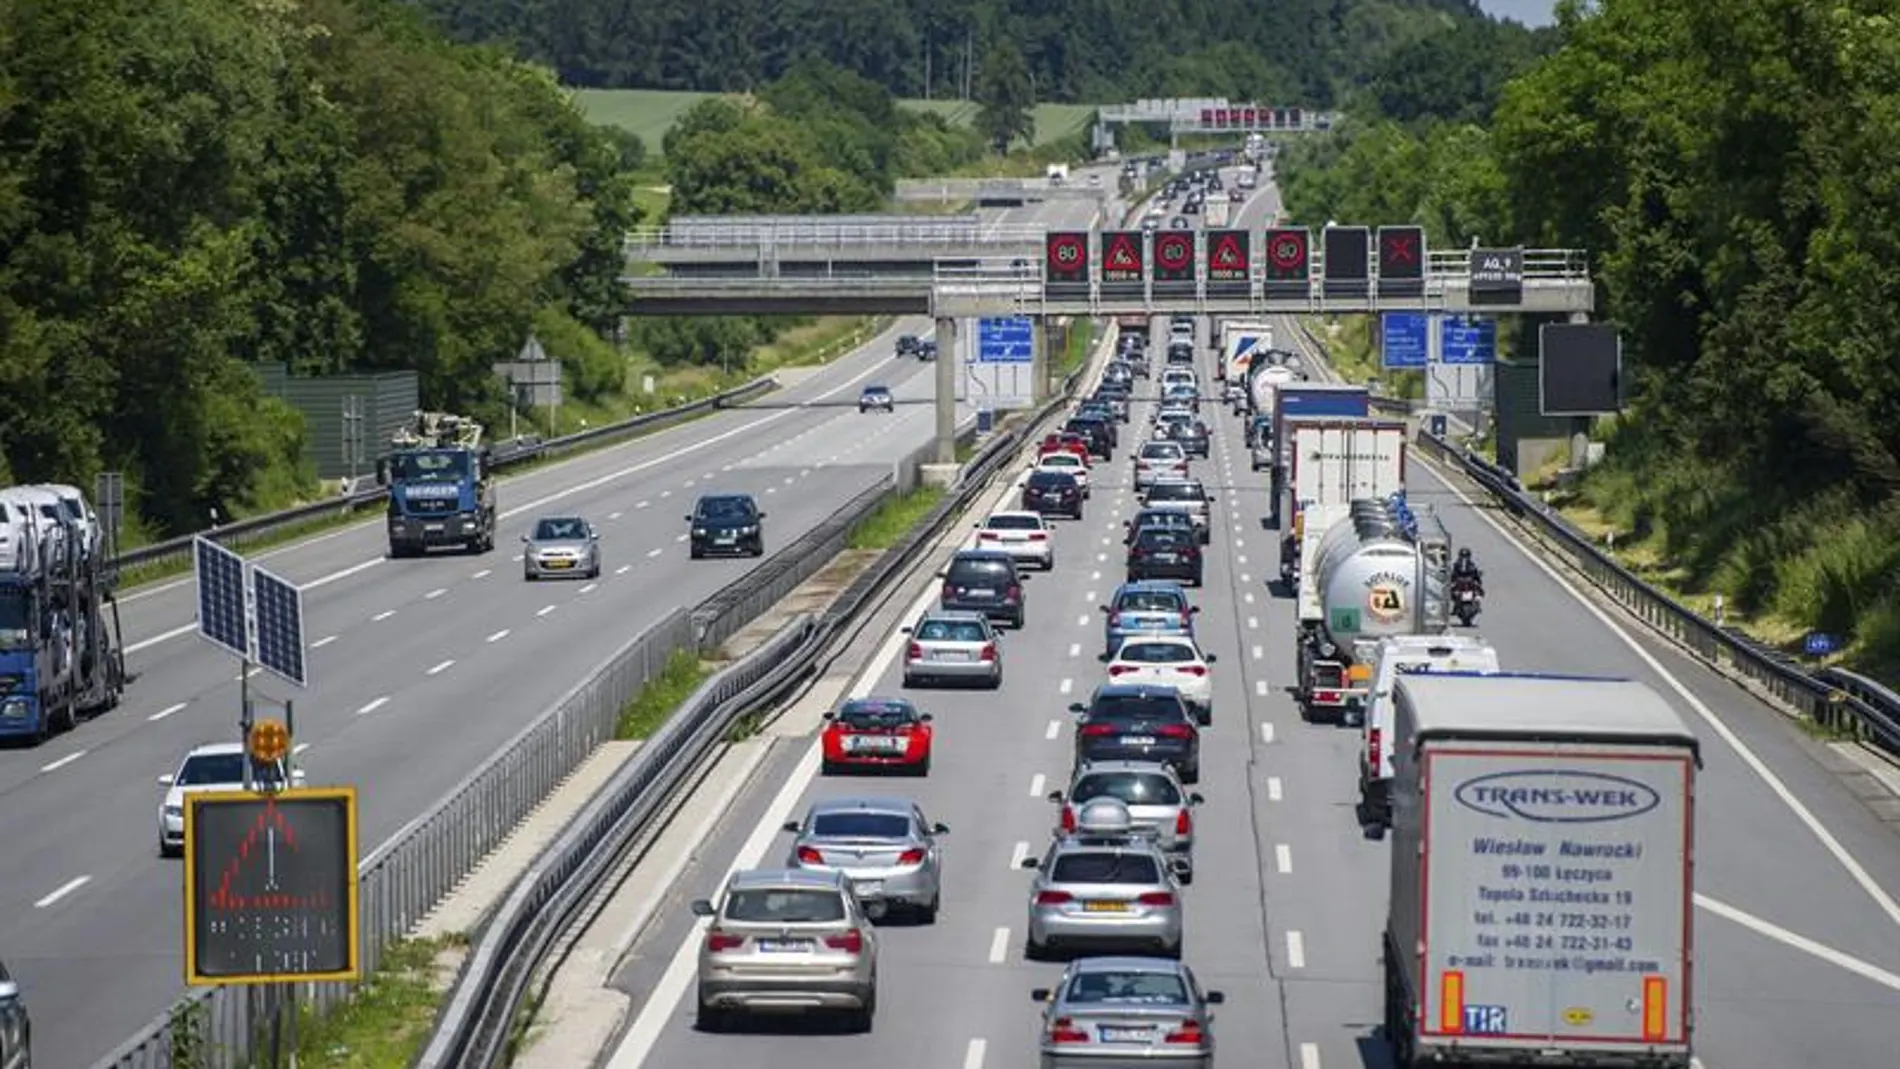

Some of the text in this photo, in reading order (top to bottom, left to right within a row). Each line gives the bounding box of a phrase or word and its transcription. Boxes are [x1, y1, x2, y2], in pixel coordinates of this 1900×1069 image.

[404, 486, 459, 500] BERGER
[1472, 786, 1638, 807] TRANS-WEK
[1535, 912, 1554, 926] 24
[1465, 1006, 1505, 1032] TIR
